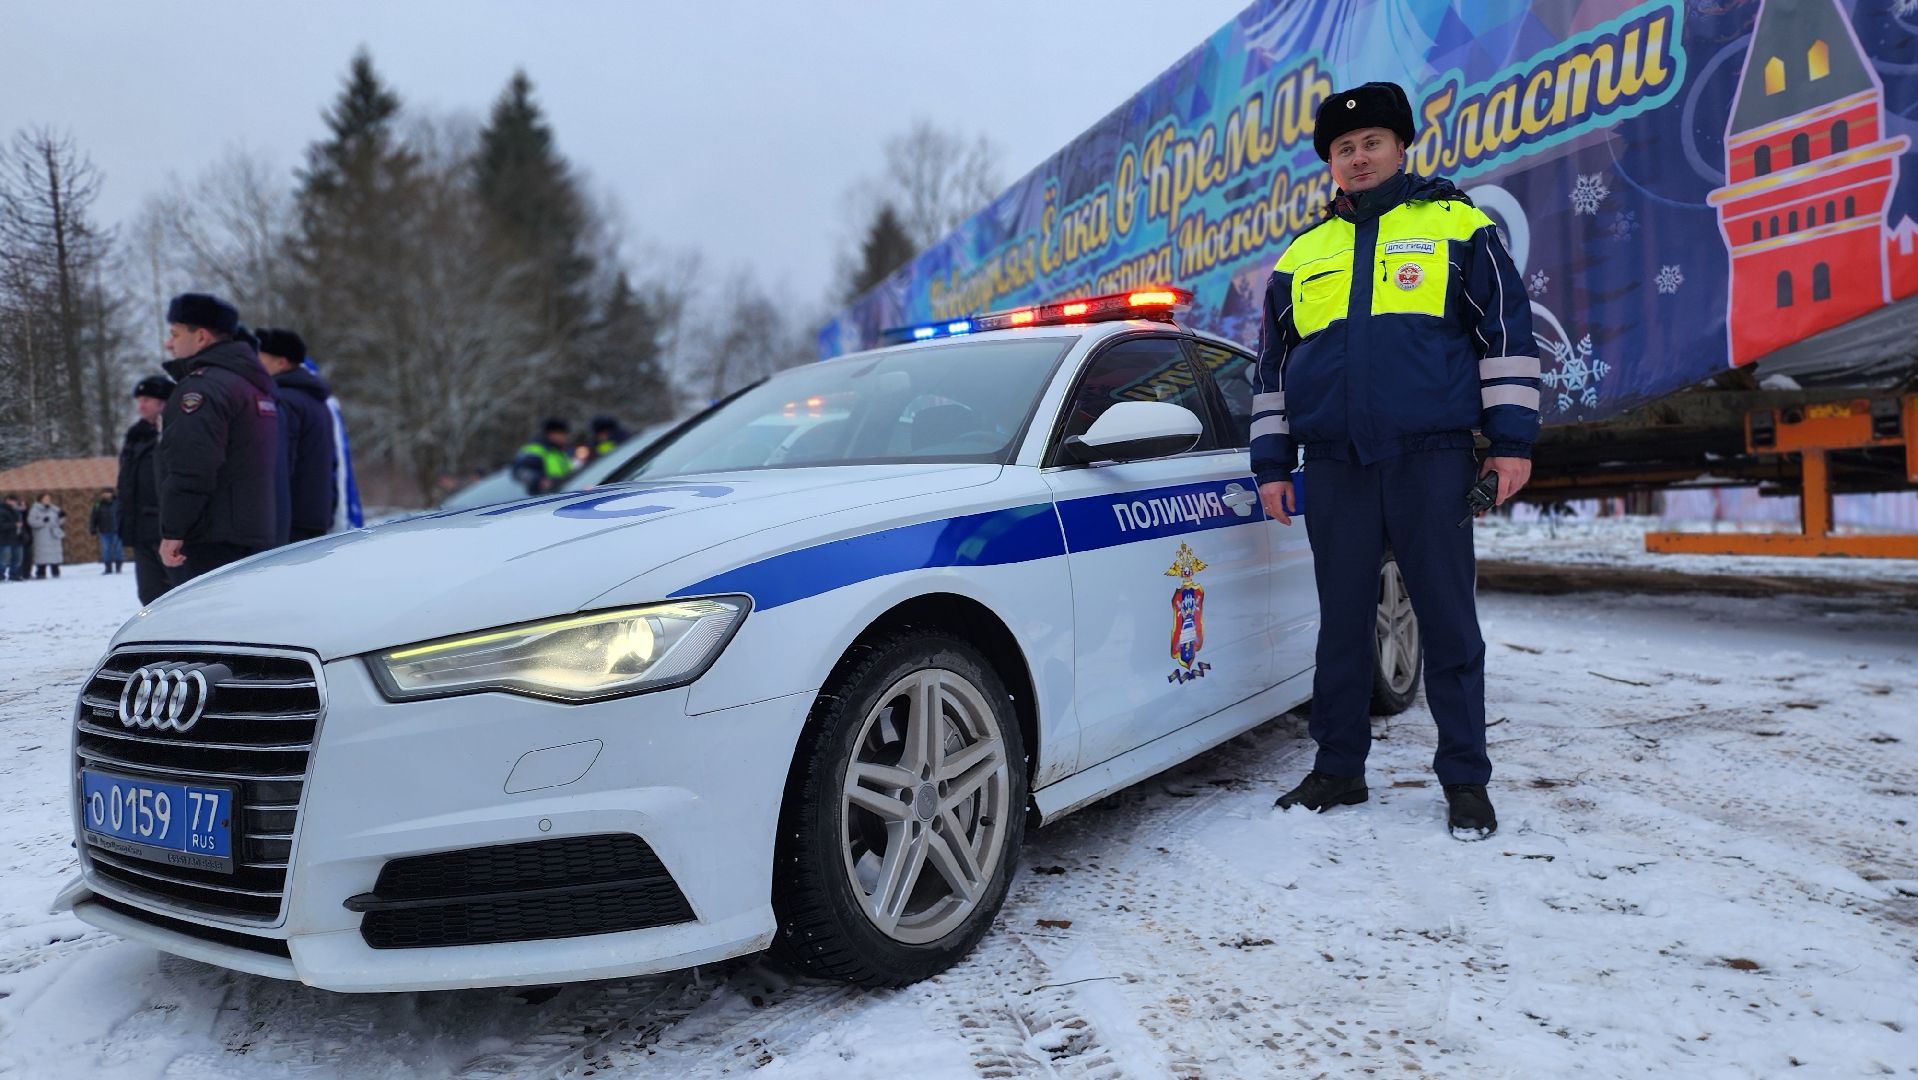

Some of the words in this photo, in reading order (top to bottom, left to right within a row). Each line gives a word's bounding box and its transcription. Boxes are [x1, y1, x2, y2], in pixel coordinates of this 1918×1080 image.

[1177, 170, 1345, 278] Московск
[1404, 16, 1668, 178] бласти
[1040, 186, 1109, 273] Ёлка
[1115, 152, 1138, 234] в
[1142, 63, 1333, 234] Кремль
[1406, 243, 1433, 251] ГИБДД
[1112, 491, 1225, 532] ПОЛИЦИЯ
[189, 792, 219, 833] 77
[192, 833, 215, 850] RUS
